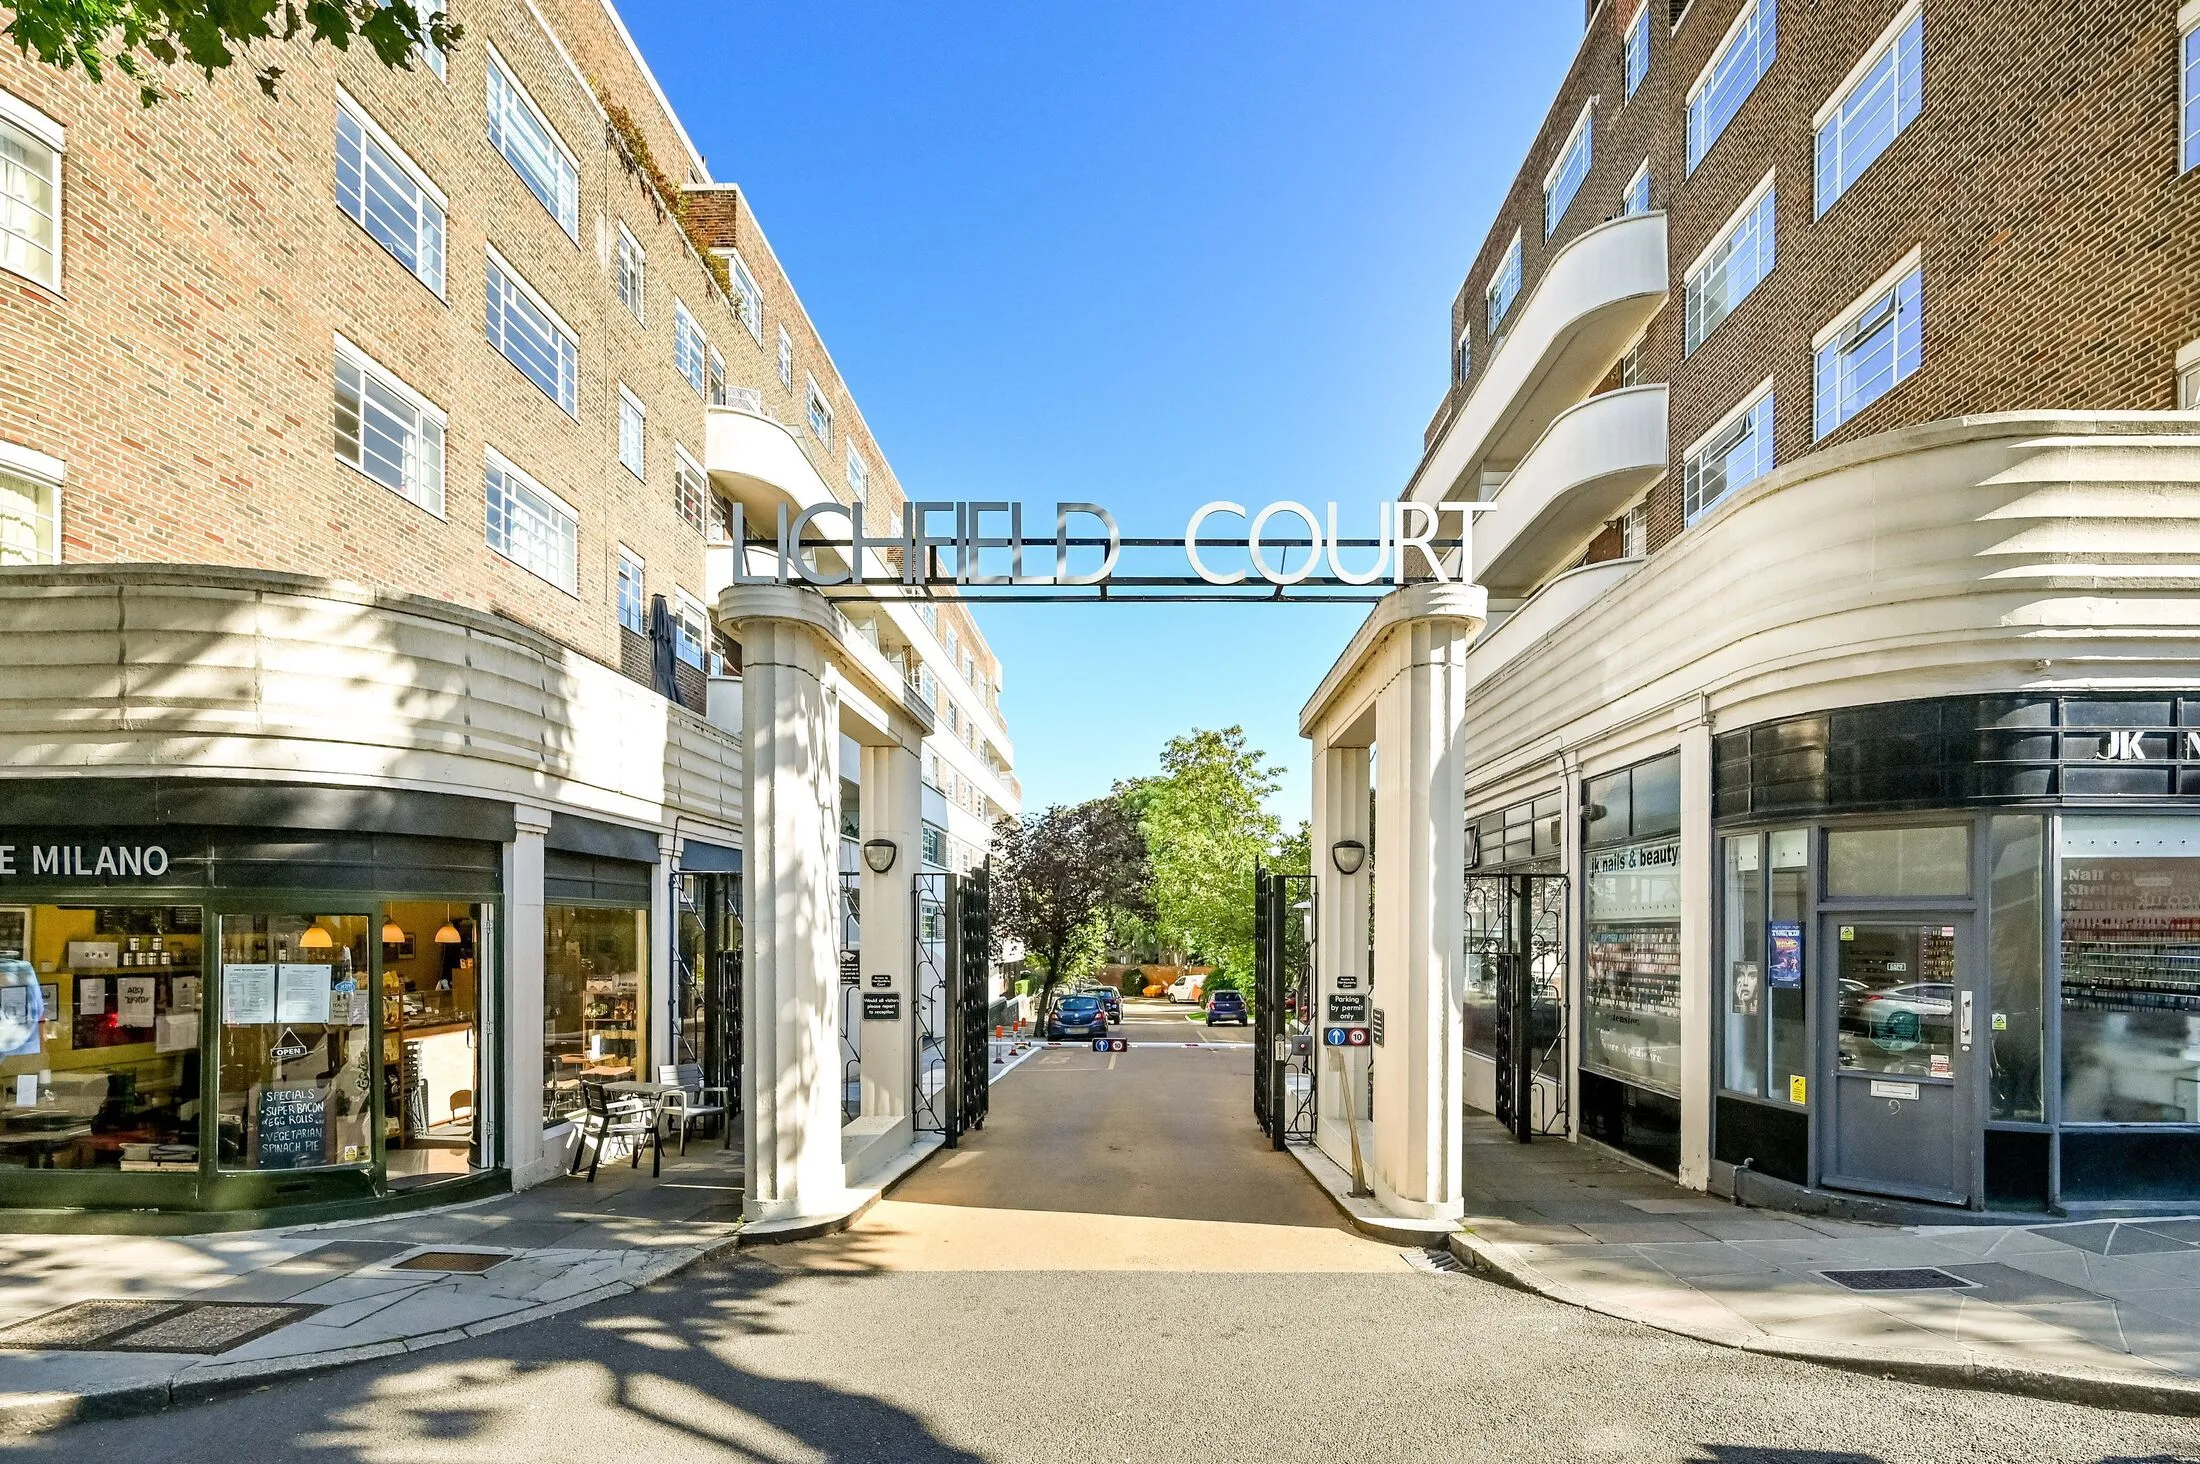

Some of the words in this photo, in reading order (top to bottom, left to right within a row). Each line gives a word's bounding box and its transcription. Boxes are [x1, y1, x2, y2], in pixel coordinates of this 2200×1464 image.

[733, 501, 1120, 584] LICHFIELD
[1185, 500, 1498, 584] COURT
[2096, 731, 2146, 760] JK
[33, 846, 168, 876] MILANO
[1590, 857, 1599, 878] jk
[1602, 853, 1625, 872] nails
[1628, 850, 1636, 868] &
[1640, 843, 1679, 867] beauty
[1335, 996, 1359, 1004] Parking
[1331, 1004, 1339, 1012] by
[1342, 1004, 1363, 1012] permit
[276, 1048, 301, 1056] OPEN
[266, 1089, 315, 1102] SPECIALS
[266, 1104, 295, 1116] SUPER
[296, 1101, 324, 1113] BACON
[289, 1114, 314, 1125] ROLLS
[266, 1128, 322, 1142] VEGETARIAN
[262, 1142, 301, 1154] SPINACH
[305, 1140, 319, 1152] PIE
